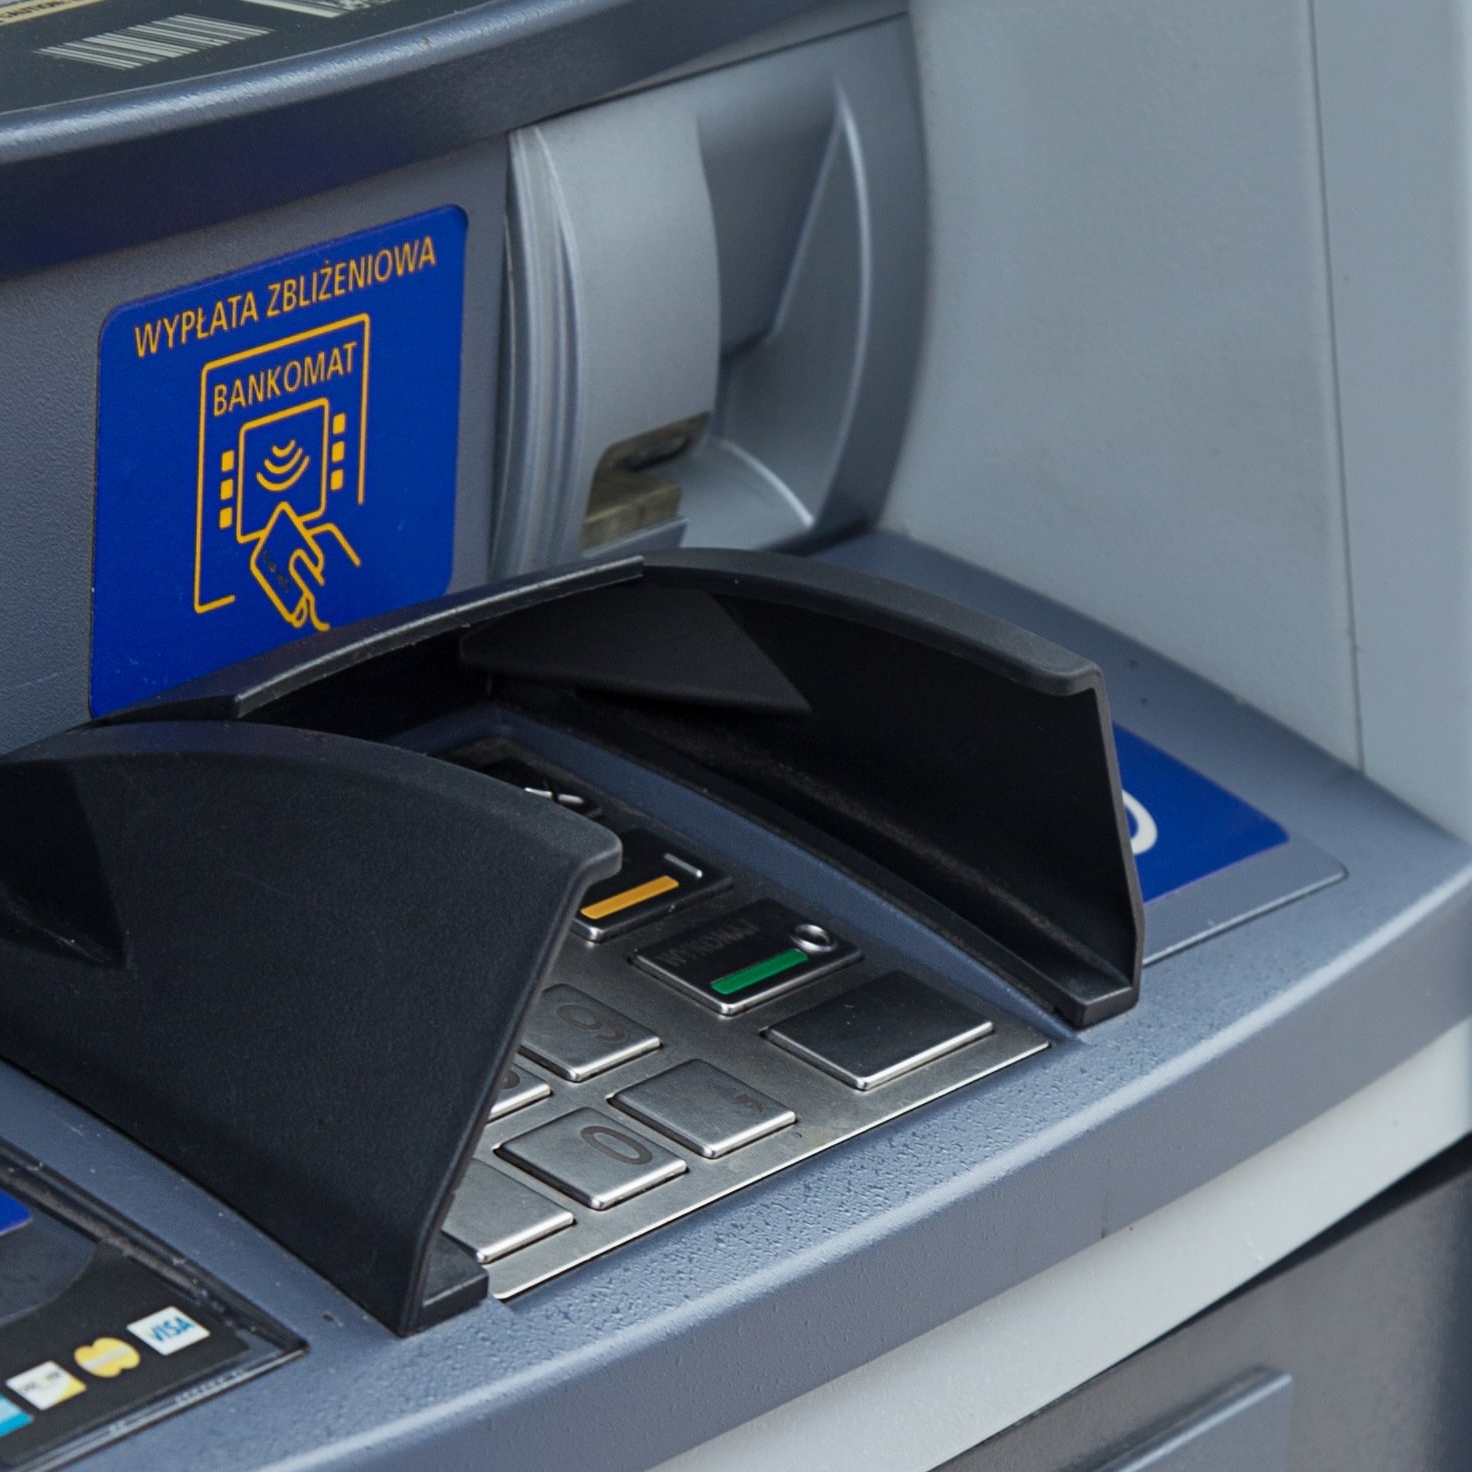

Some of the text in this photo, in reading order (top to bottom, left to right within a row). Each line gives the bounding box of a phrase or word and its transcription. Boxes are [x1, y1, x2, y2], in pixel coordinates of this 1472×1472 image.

[134, 236, 437, 358] WYPŁATA ZBLIŻENIOWA
[213, 341, 357, 416] BANKOMAT
[556, 1003, 628, 1043] 9
[580, 1125, 653, 1165] 0
[150, 1317, 193, 1342] VISA
